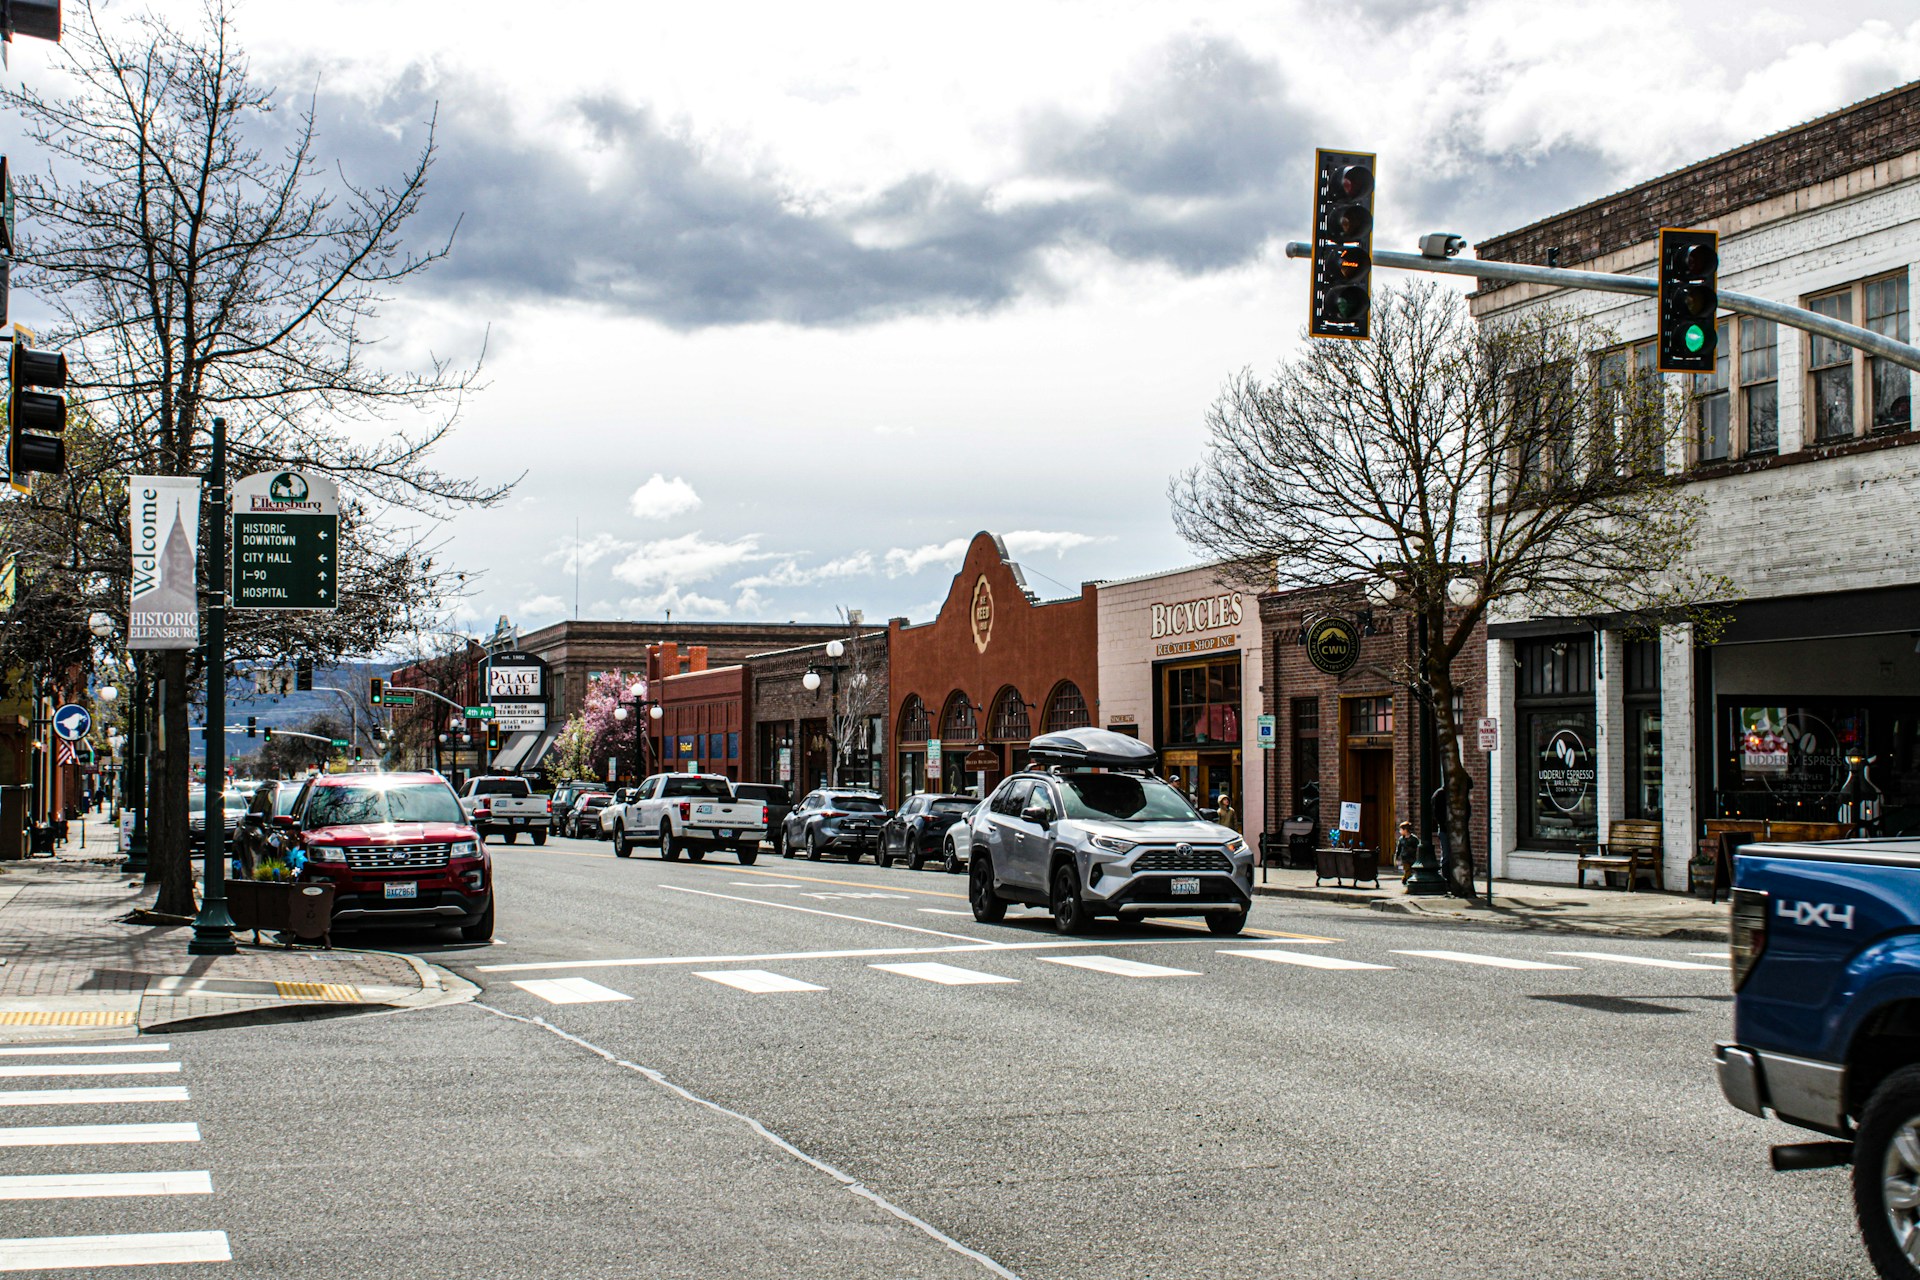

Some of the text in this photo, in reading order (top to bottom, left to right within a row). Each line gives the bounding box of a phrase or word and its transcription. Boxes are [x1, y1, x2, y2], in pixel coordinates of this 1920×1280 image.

[251, 497, 322, 513] Ellensburg
[243, 523, 286, 534] HISTORIC
[133, 489, 157, 597] Welcome
[243, 535, 296, 546] DOWNTOWN
[243, 552, 292, 563] CITY HALL
[243, 570, 267, 580] I-90
[243, 588, 288, 598] HOSPITAL
[130, 612, 198, 626] HISTORIC
[977, 607, 990, 620] REED
[1151, 591, 1243, 639] BICYCLES
[130, 627, 198, 638] ELLENSBURG
[1313, 621, 1348, 640] WASHINGTON
[1321, 645, 1347, 655] CWU
[490, 671, 538, 686] PALACE
[496, 685, 530, 695] CAFE
[1748, 755, 1798, 766] UDDERLY
[1538, 769, 1595, 779] UDDERLY ESPRESSO
[1776, 899, 1856, 930] 4X4
